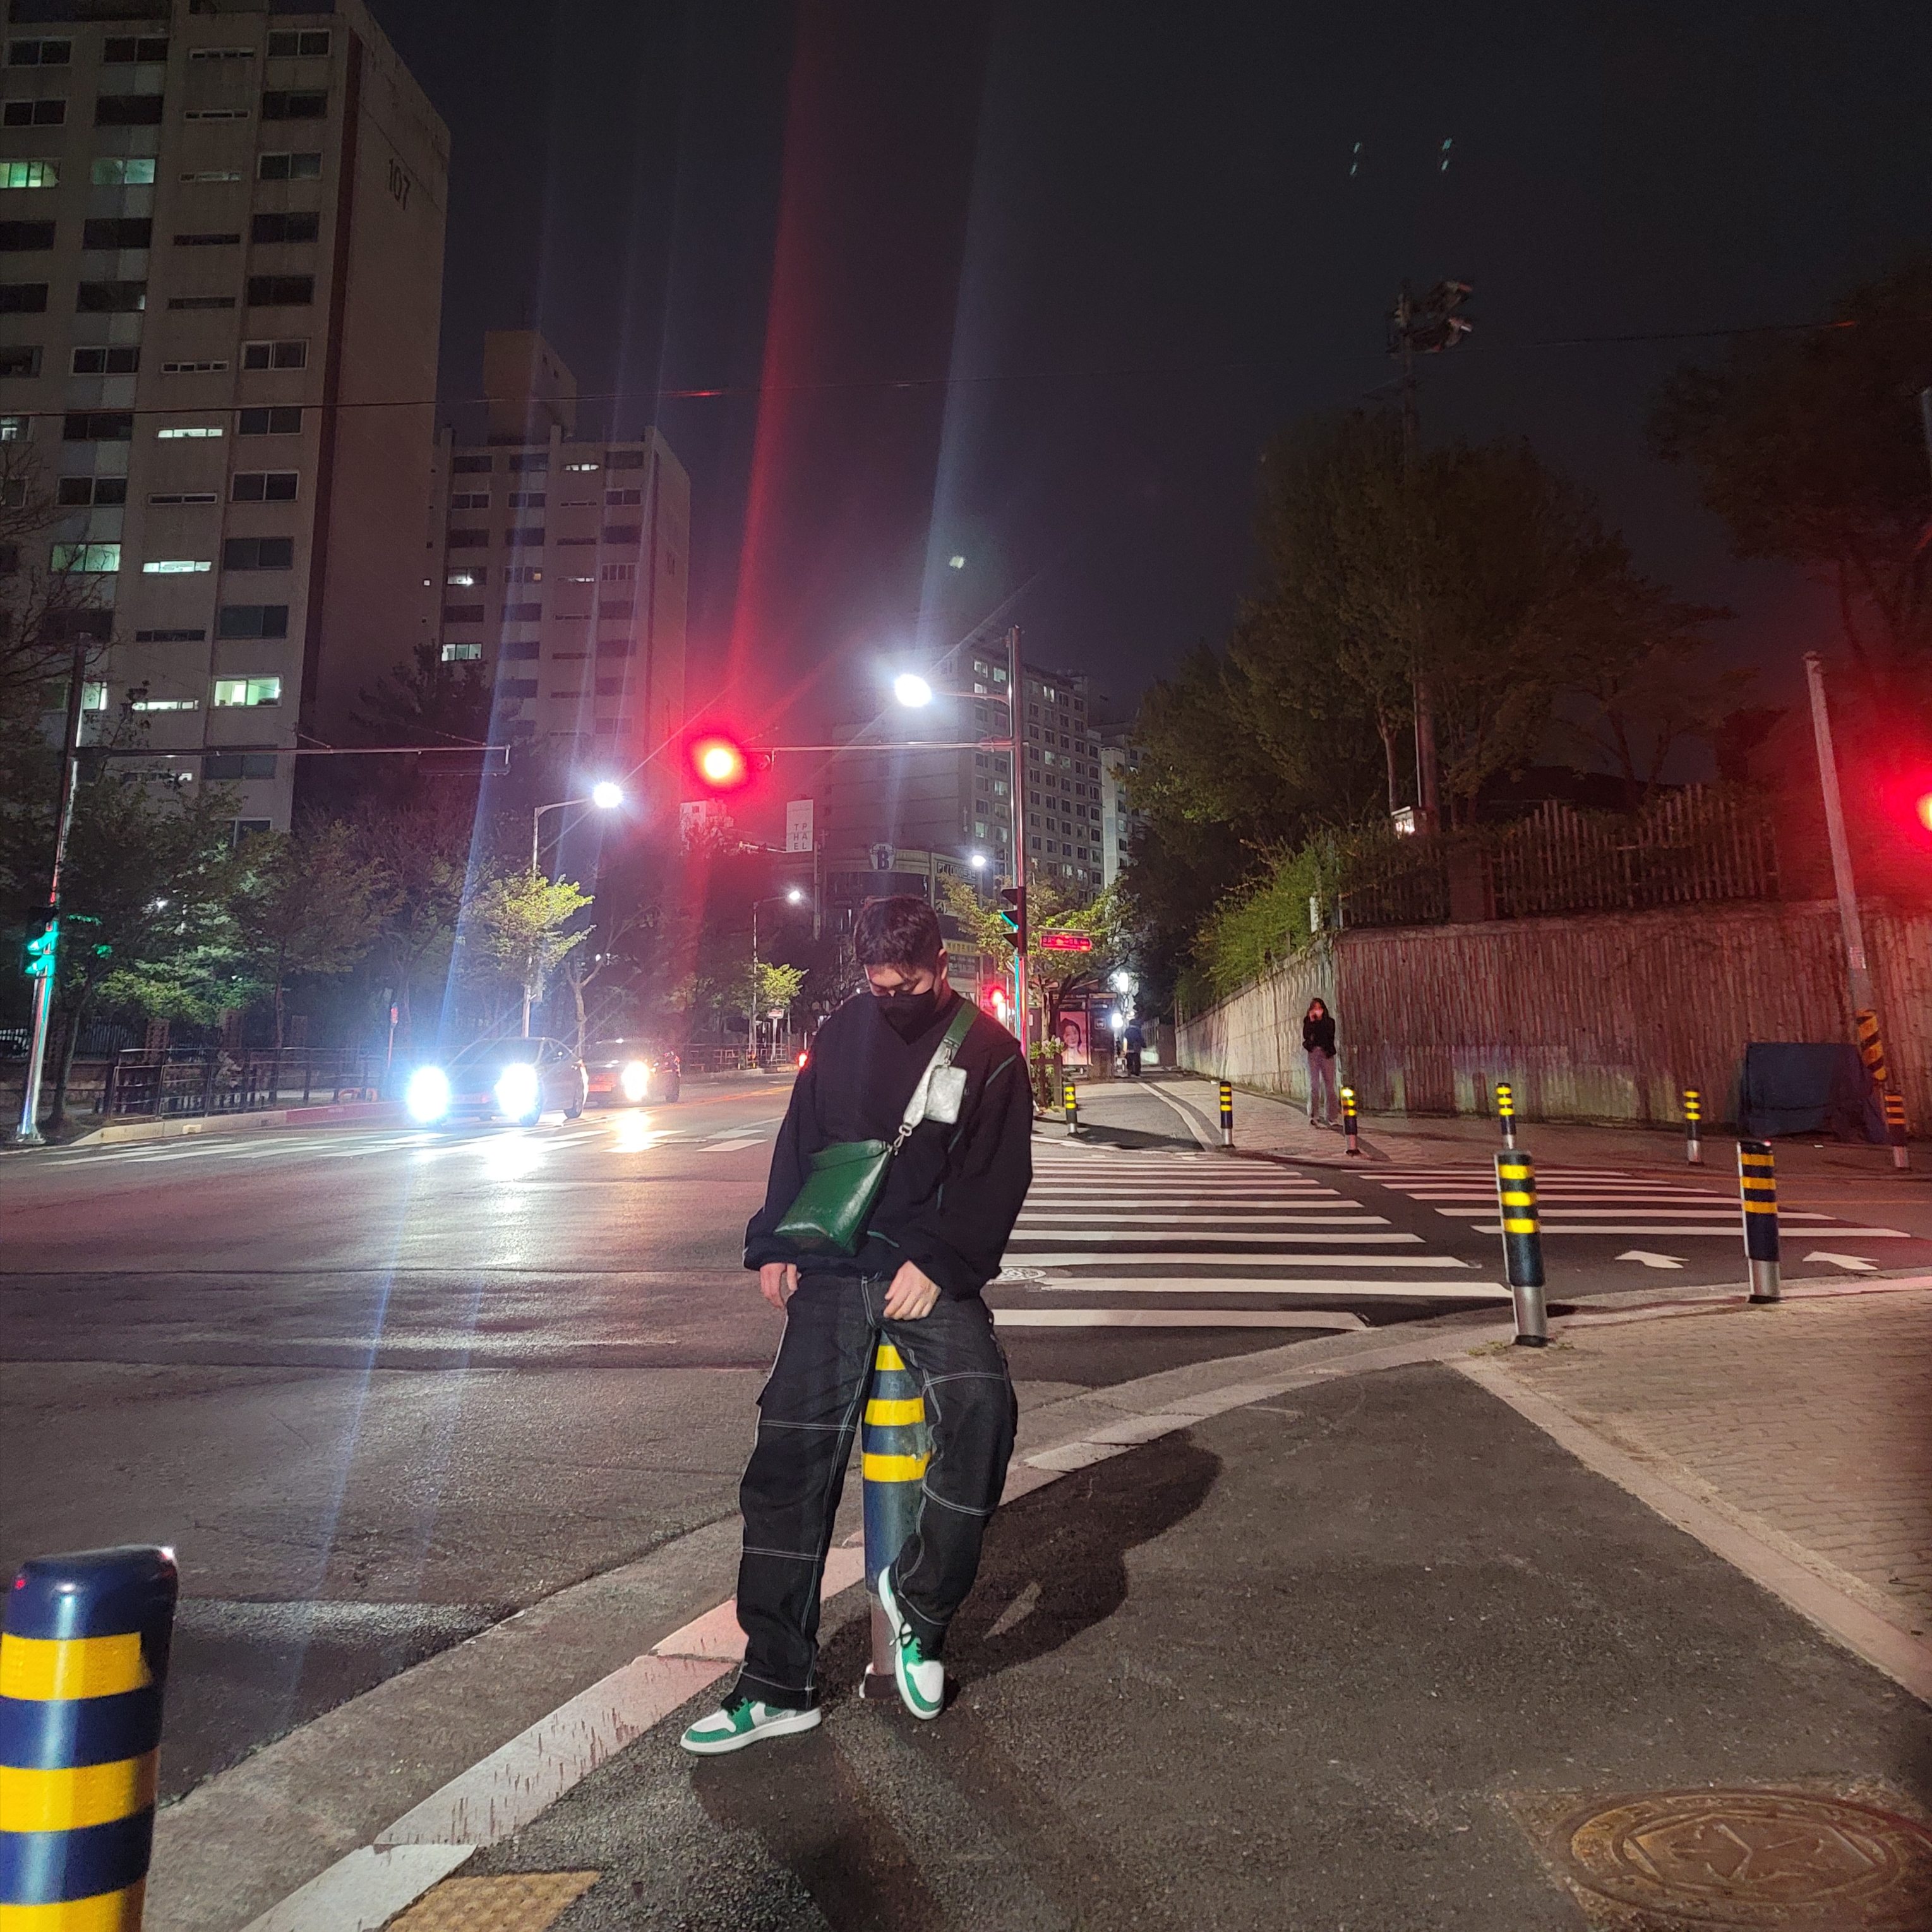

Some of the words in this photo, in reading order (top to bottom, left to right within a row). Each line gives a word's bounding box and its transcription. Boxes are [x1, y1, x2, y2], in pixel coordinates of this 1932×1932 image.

[388, 158, 411, 211] 107
[877, 850, 889, 870] B
[938, 863, 945, 873] PT
